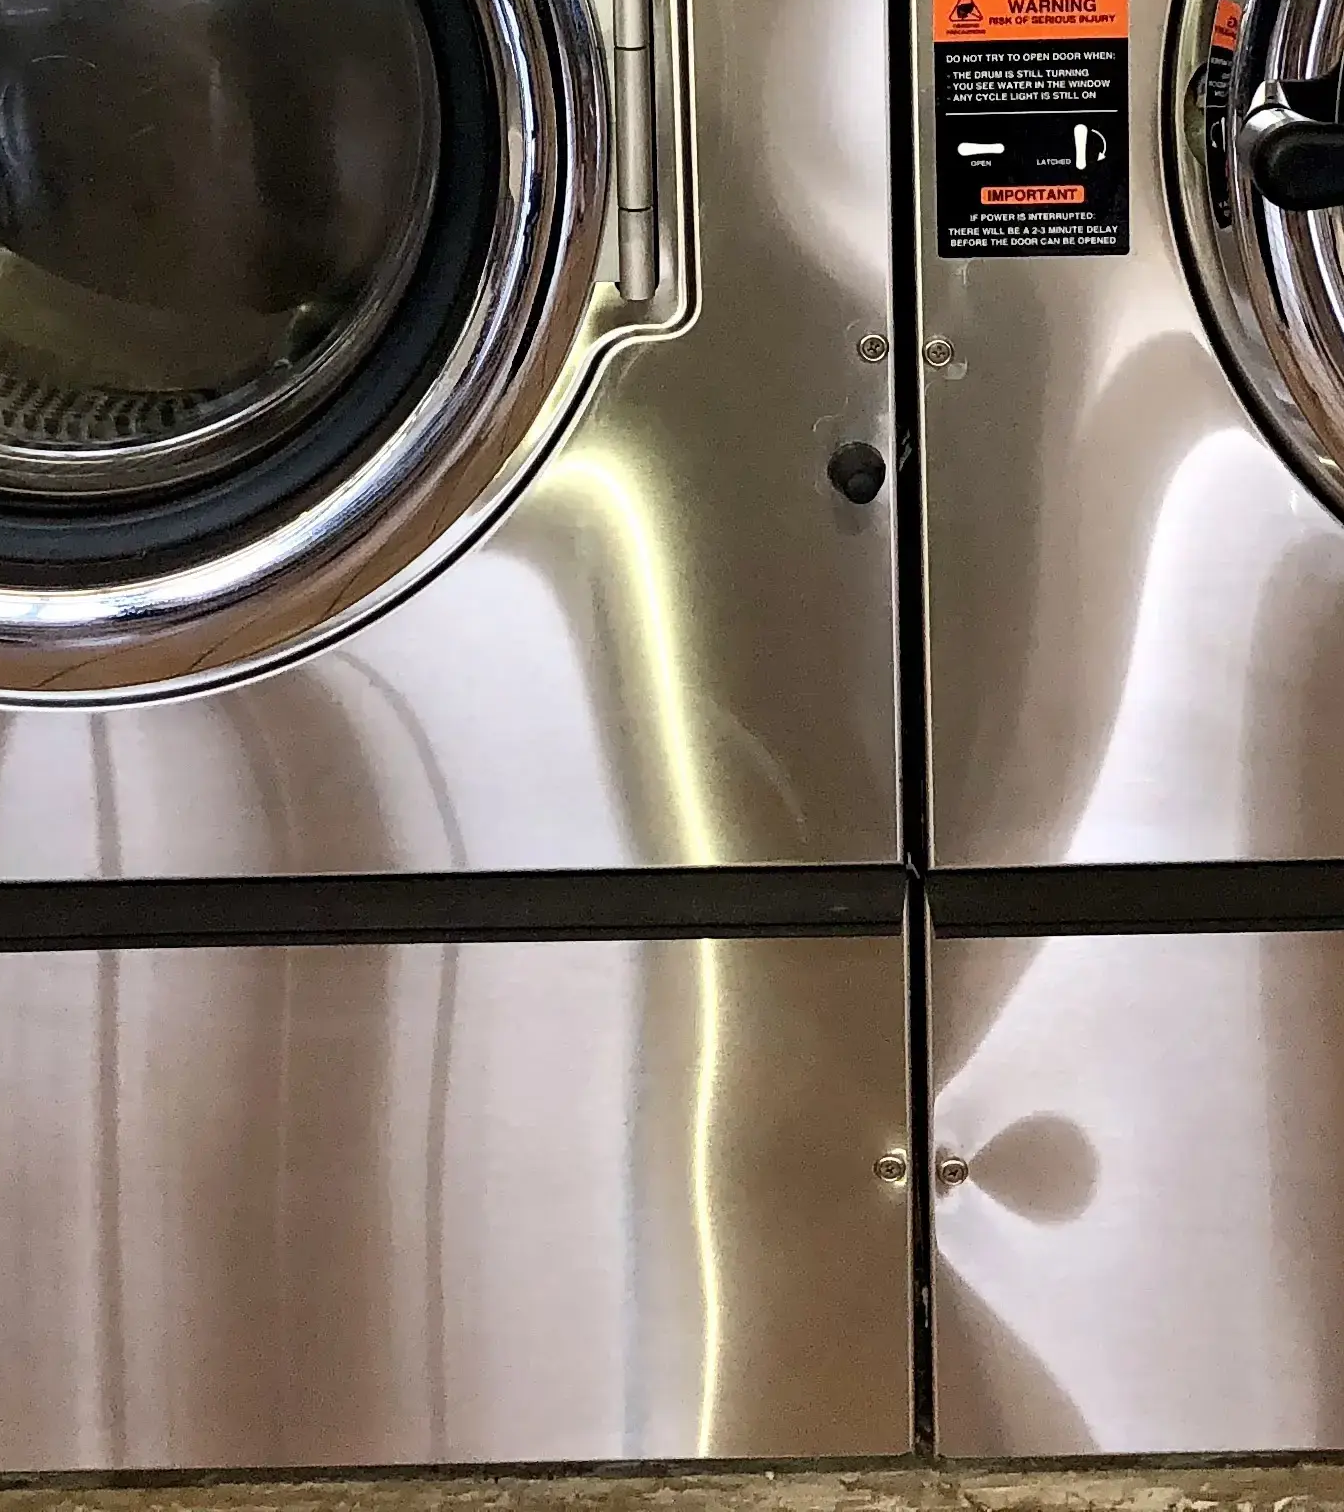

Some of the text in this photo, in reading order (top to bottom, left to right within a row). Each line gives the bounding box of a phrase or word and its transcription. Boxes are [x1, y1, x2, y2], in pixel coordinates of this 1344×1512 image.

[989, 14, 1116, 25] RISK OF SERIOUS INJURY
[946, 51, 1116, 64] DO NOT TRY TO OPEN DOOR WHEN:
[953, 68, 1089, 80] THE DRUM IS STILL TURNING
[953, 79, 1110, 91] YOU SEE WATER IN THE WINDOW
[953, 91, 1096, 102] ANY CYCLE LIGHT IS STILL ON
[1036, 158, 1071, 166] LATCHED
[987, 188, 1077, 202] IMPORTANT
[970, 214, 979, 222] IF
[980, 213, 1015, 222] POWER
[1017, 213, 1026, 221] IS
[948, 225, 1118, 236] THERE WILL BE A 2-3 MINUTE DELAY
[950, 236, 1116, 247] BEFORE THE DOOR CAN BE OPENED
